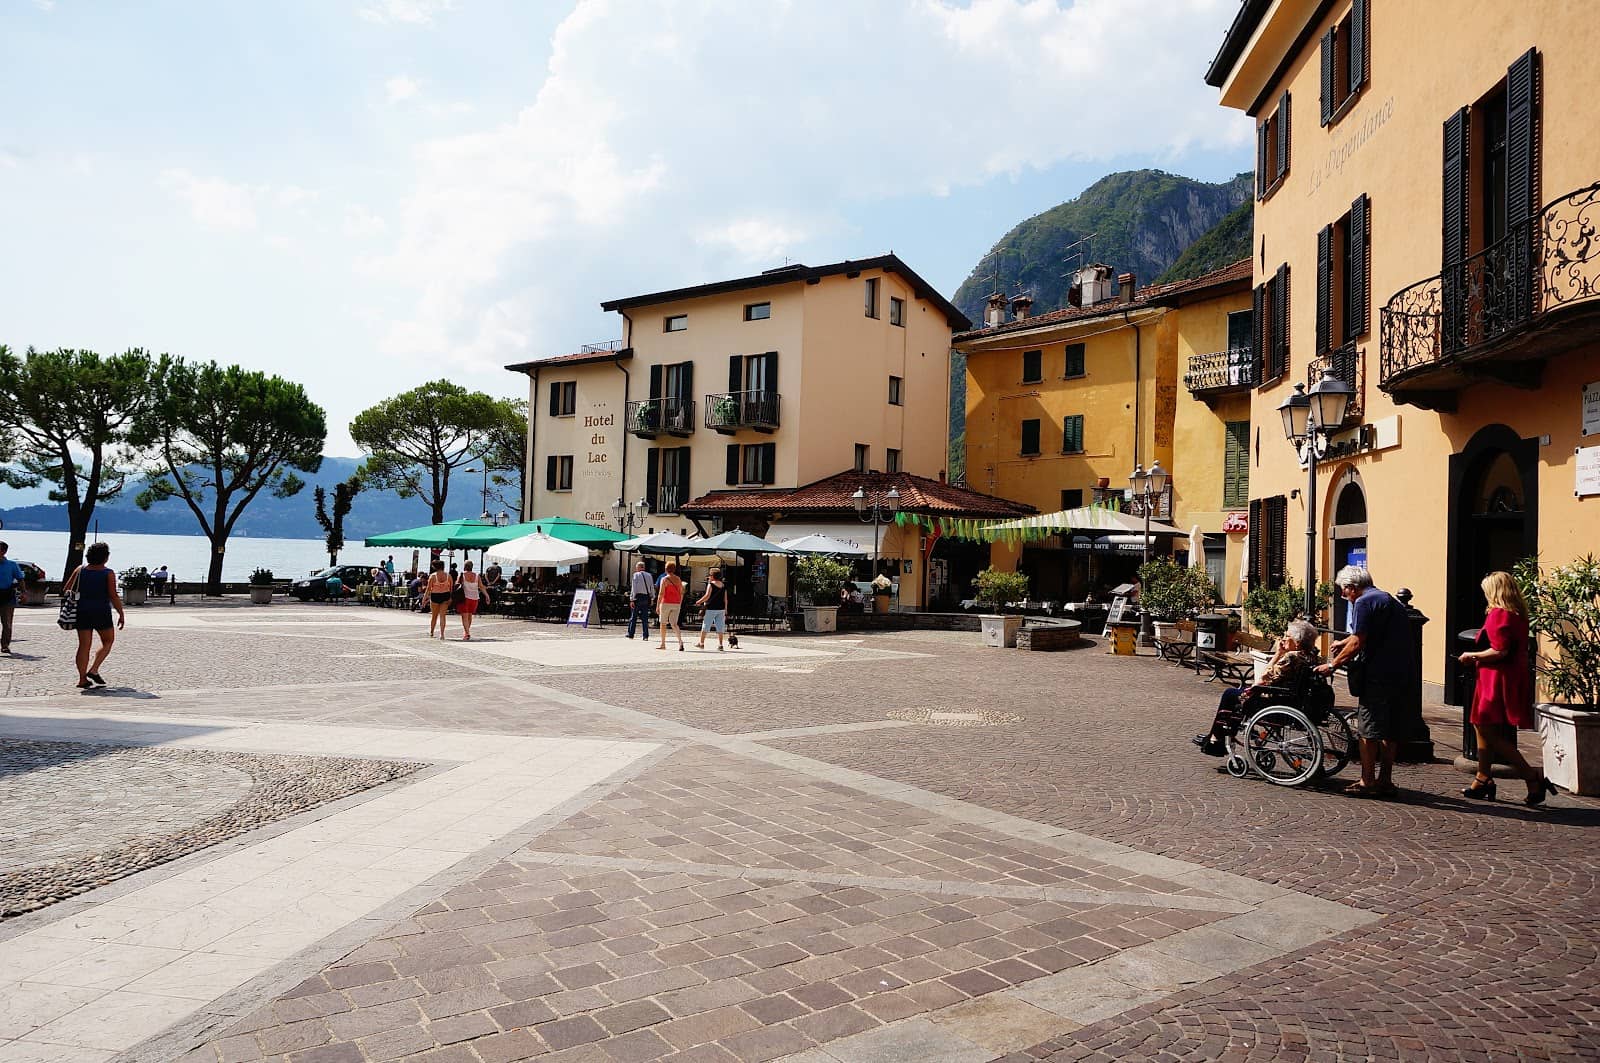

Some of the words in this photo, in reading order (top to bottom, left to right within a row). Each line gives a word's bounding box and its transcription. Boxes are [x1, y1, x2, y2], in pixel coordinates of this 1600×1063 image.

[1584, 391, 1600, 404] PIAZZ
[584, 413, 614, 427] Hotel
[591, 433, 605, 444] du
[588, 451, 607, 463] Lac
